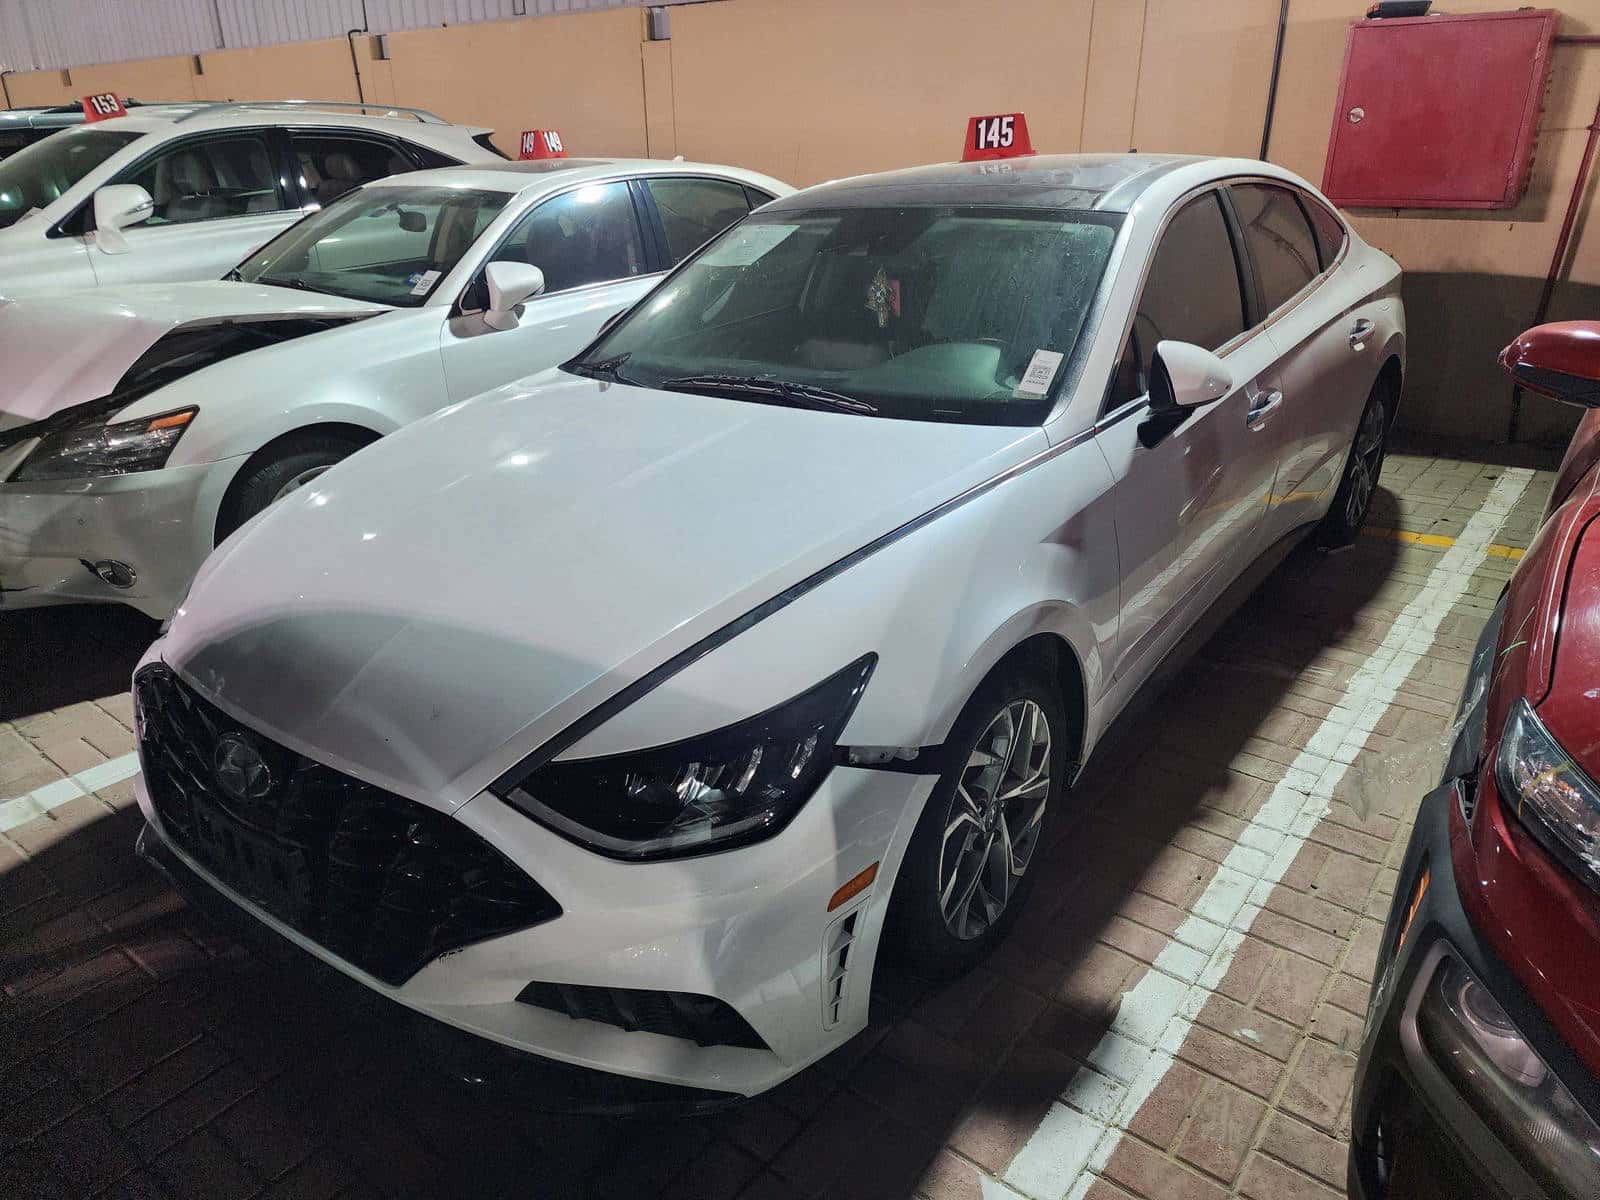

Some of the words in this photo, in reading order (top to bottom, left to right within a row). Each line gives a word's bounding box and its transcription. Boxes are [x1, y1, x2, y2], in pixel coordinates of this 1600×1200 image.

[91, 94, 120, 115] 153
[543, 131, 563, 152] 149
[978, 116, 1014, 149] 145
